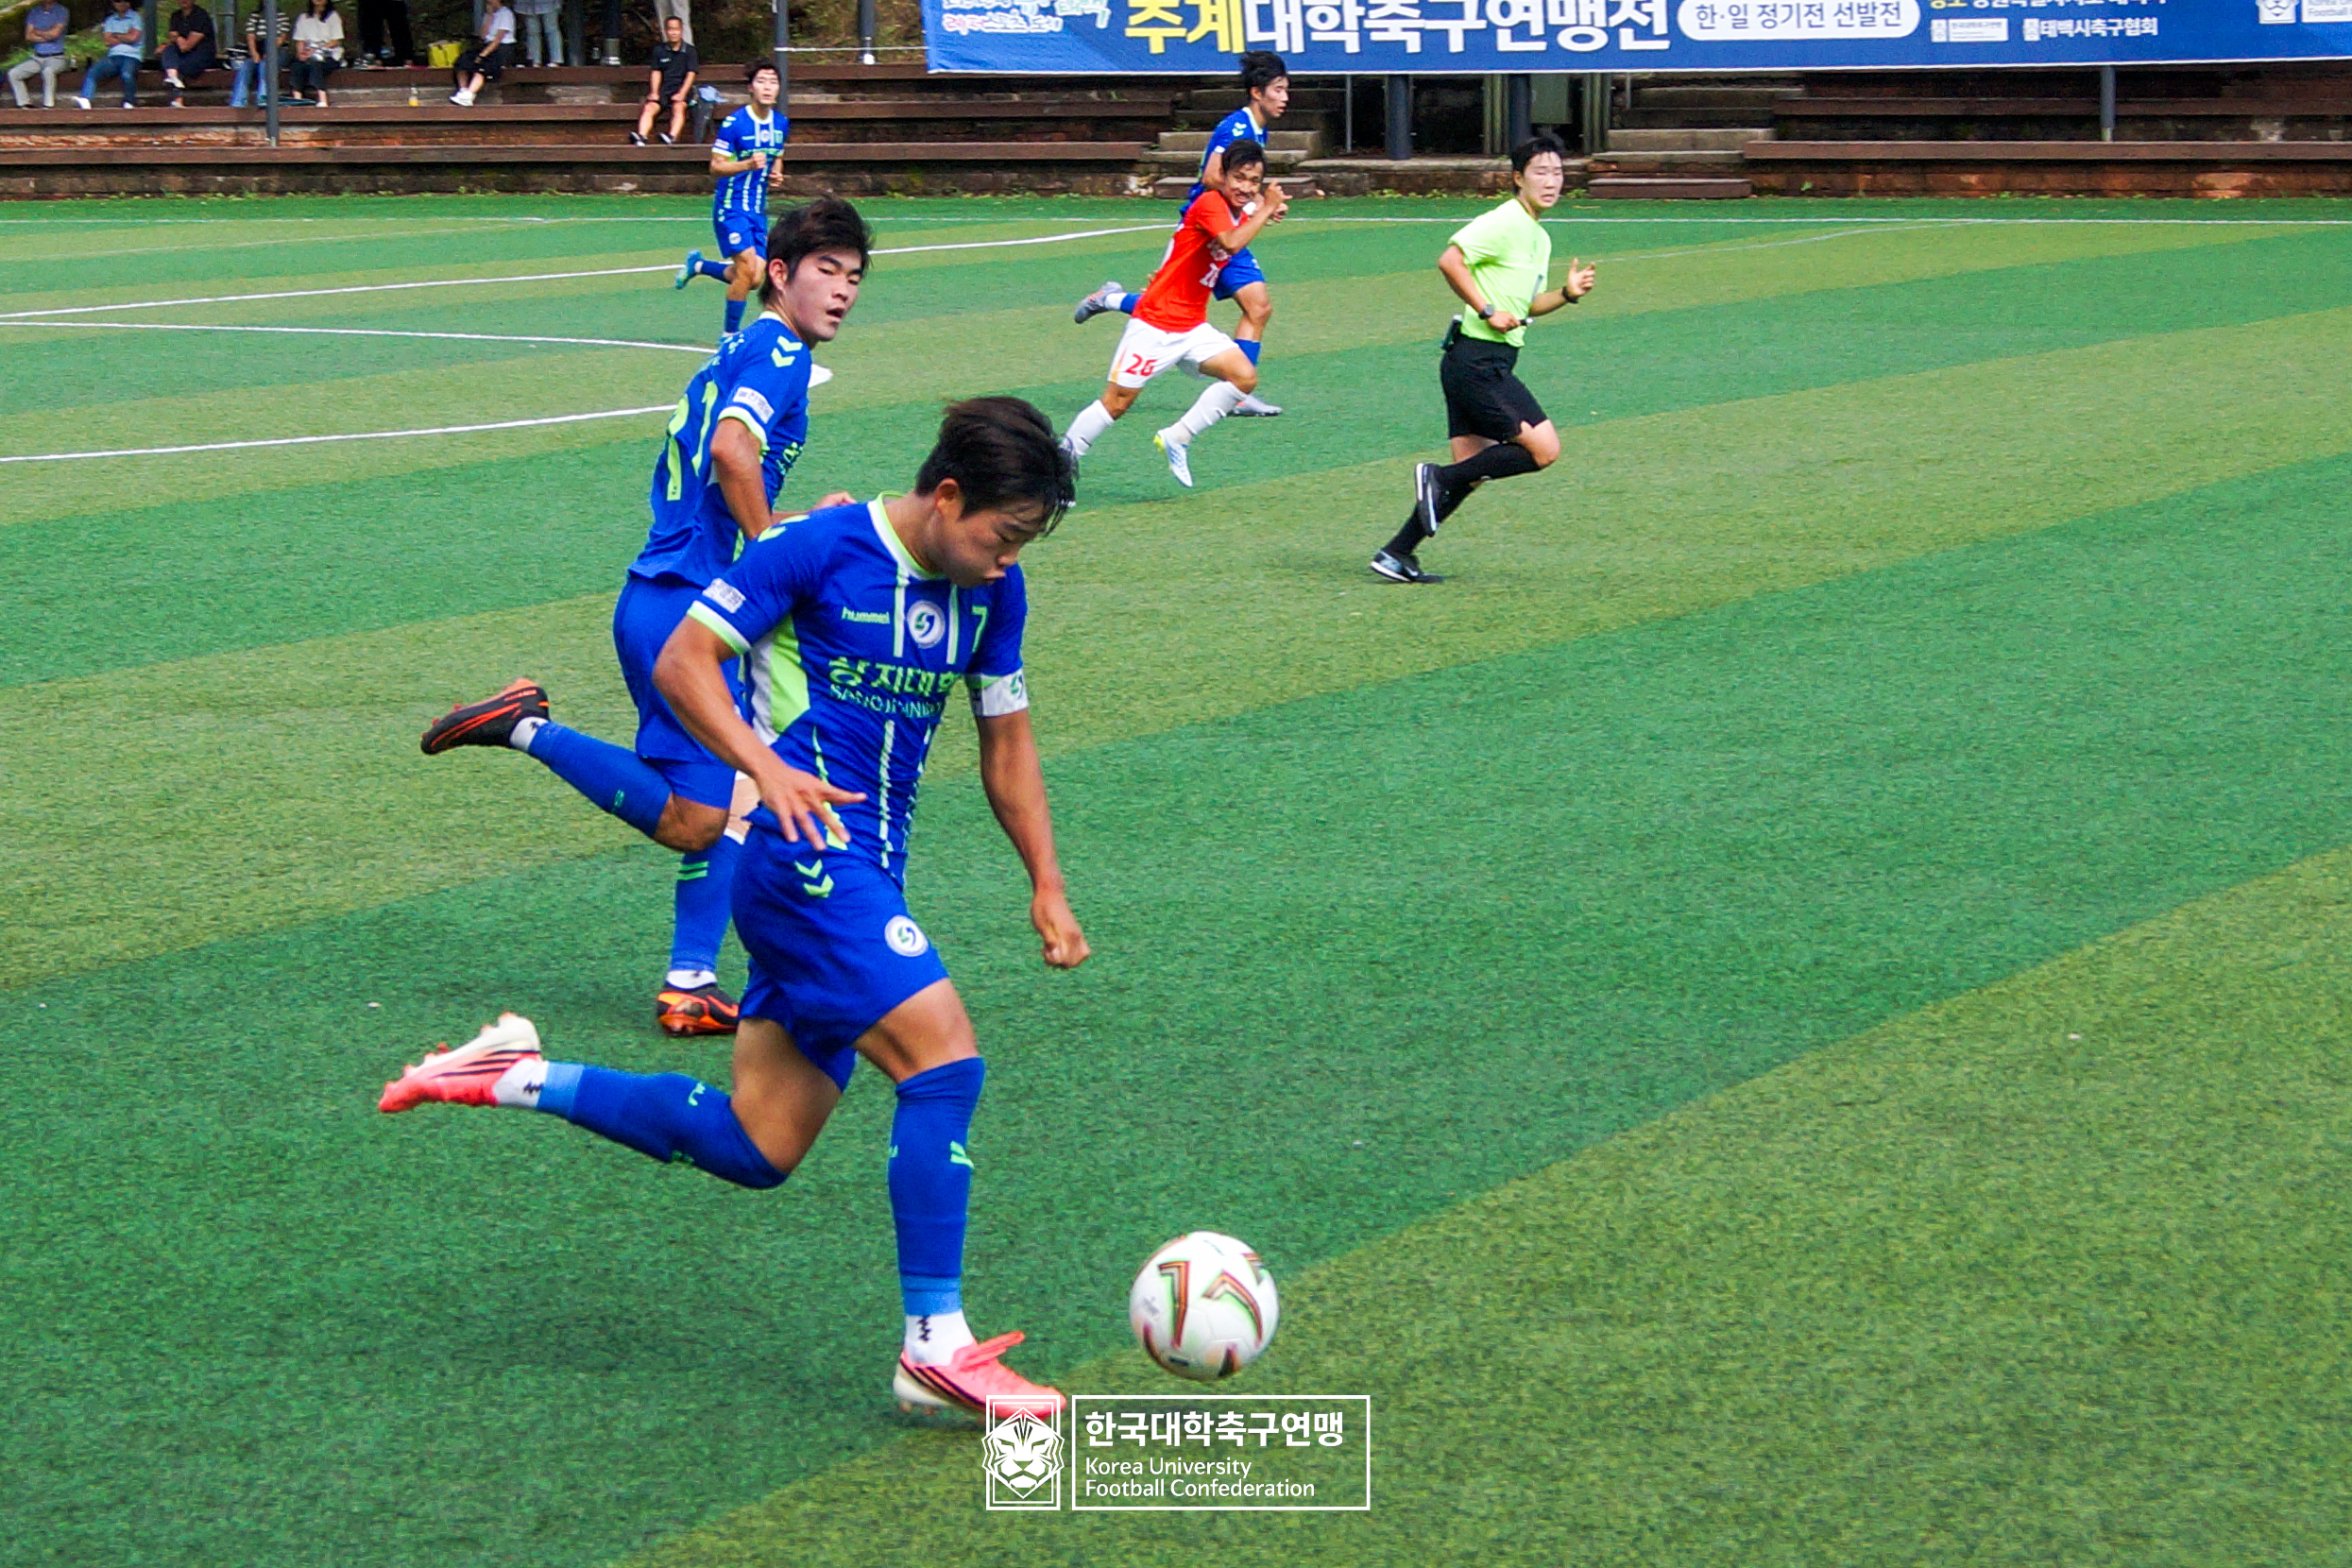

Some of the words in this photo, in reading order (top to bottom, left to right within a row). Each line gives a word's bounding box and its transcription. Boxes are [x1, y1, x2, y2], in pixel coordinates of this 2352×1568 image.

[1757, 2, 1826, 29] 정기전
[1832, 1, 1903, 28] 선발전
[1124, 352, 1157, 376] 26
[971, 605, 989, 654] 7
